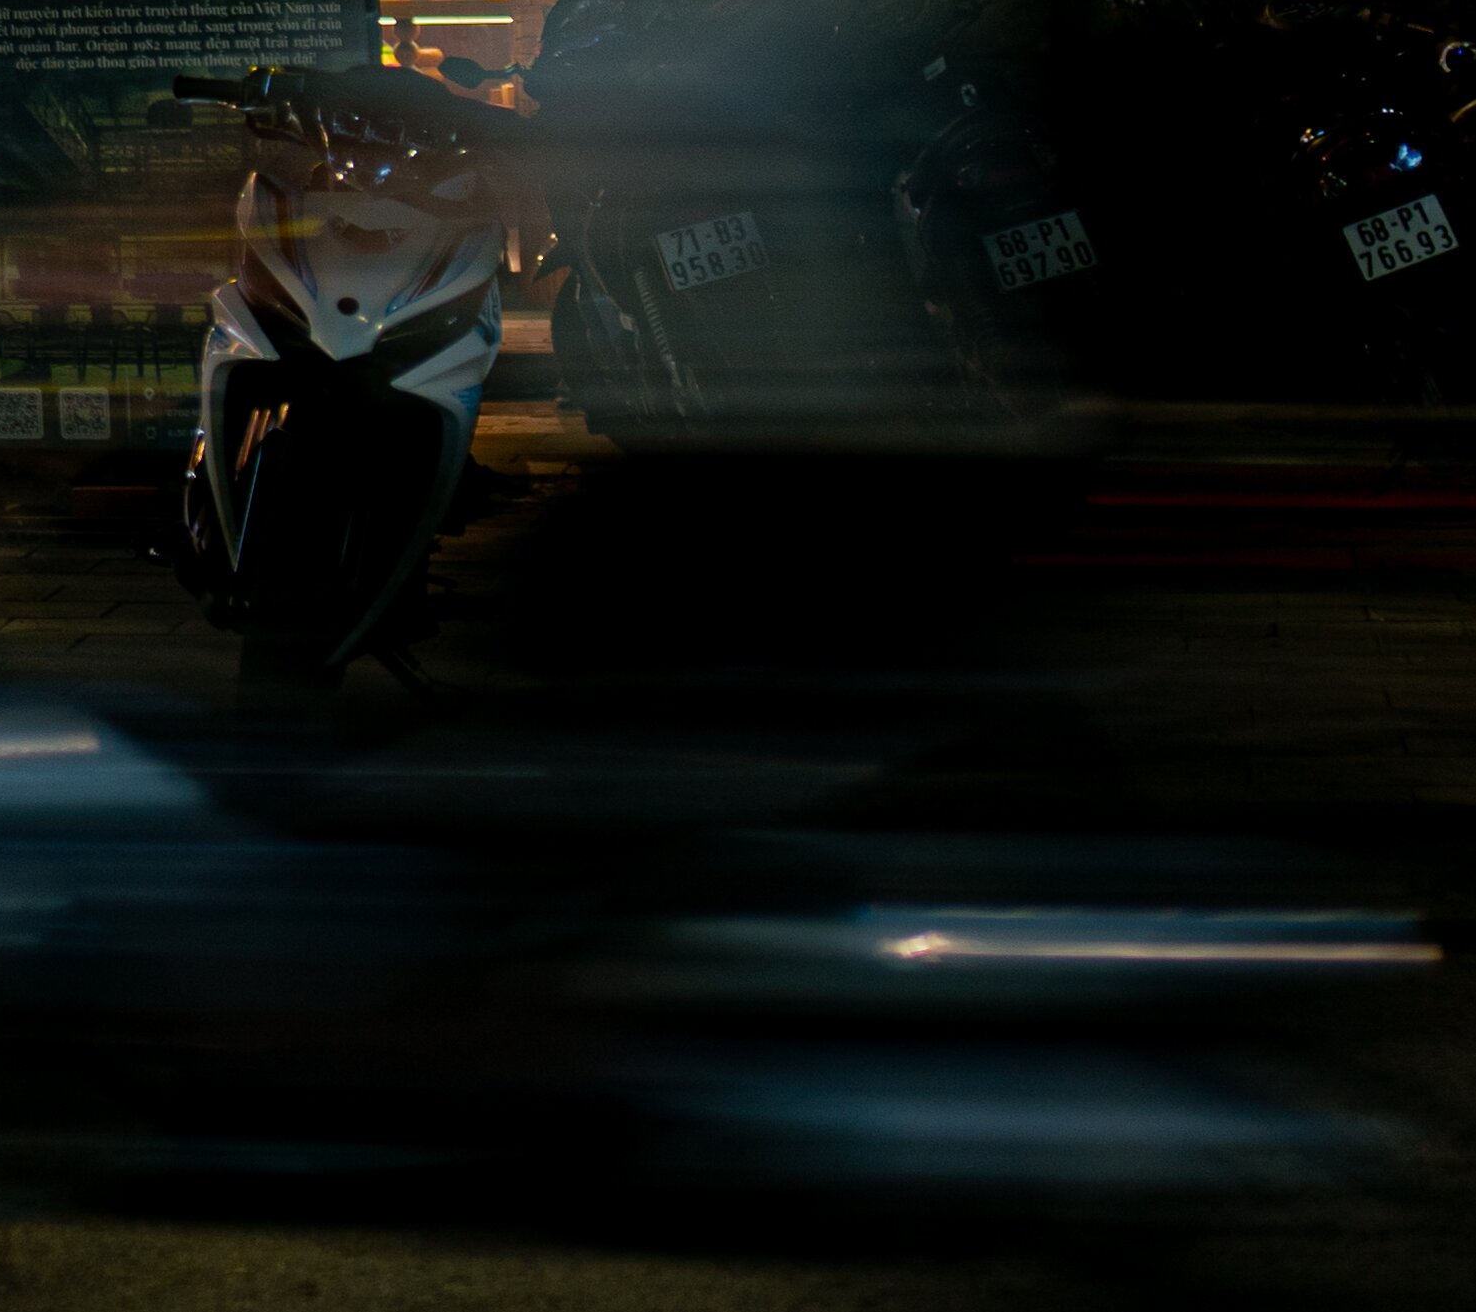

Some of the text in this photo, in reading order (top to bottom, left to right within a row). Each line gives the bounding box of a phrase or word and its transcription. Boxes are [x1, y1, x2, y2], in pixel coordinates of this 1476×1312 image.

[13, 6, 59, 22] nguyên
[61, 6, 82, 19] nét
[115, 4, 142, 17] trúc
[191, 0, 228, 17] thống
[231, 2, 254, 15] của
[255, 2, 282, 16] Việt
[284, 1, 314, 14] Nam
[318, 1, 341, 13] xưa
[60, 23, 100, 37] phong
[103, 21, 132, 35] cách
[205, 22, 235, 34] sang
[67, 56, 95, 70] giao
[97, 55, 125, 69] thoa
[86, 39, 128, 54] Origin
[165, 40, 201, 52] mang
[995, 216, 1073, 259] 68-P1
[1357, 202, 1431, 247] 68-P1
[999, 242, 1095, 289] 697.90
[1359, 225, 1455, 279] 766.93
